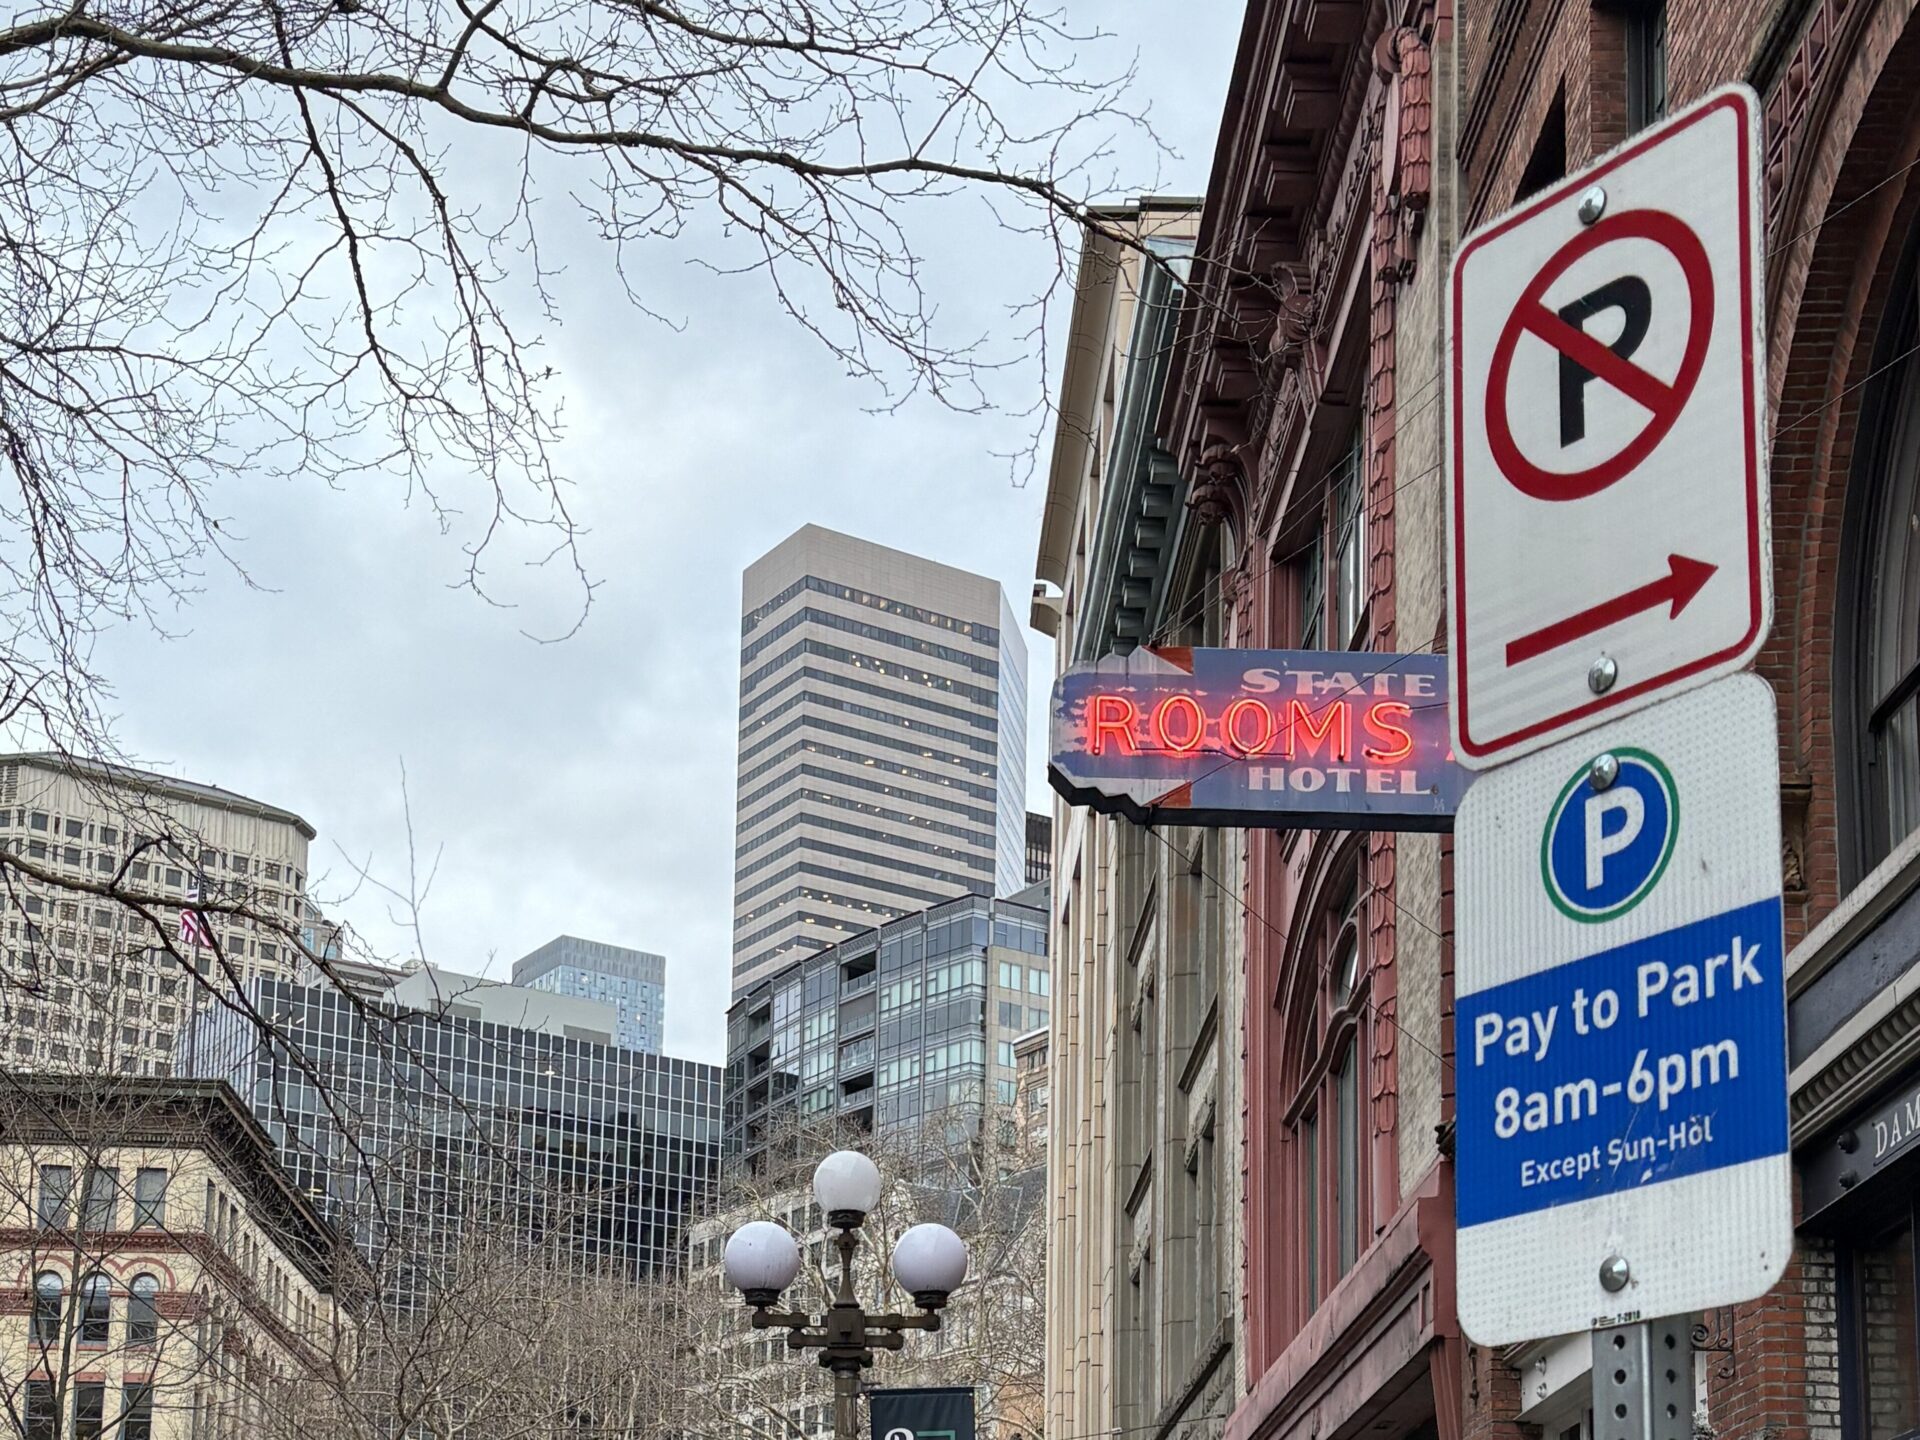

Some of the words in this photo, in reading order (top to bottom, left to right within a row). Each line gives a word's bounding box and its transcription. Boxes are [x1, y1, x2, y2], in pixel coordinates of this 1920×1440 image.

[1240, 668, 1437, 697] STATE
[1087, 695, 1416, 765] ROOMS
[1248, 766, 1431, 795] HOTEL
[1585, 786, 1645, 890] P
[1475, 1005, 1559, 1066] Pay
[1572, 988, 1620, 1035] to
[1637, 935, 1764, 1018] Park
[1494, 1038, 1740, 1139] 8am-6pm
[1521, 1146, 1601, 1187] Except
